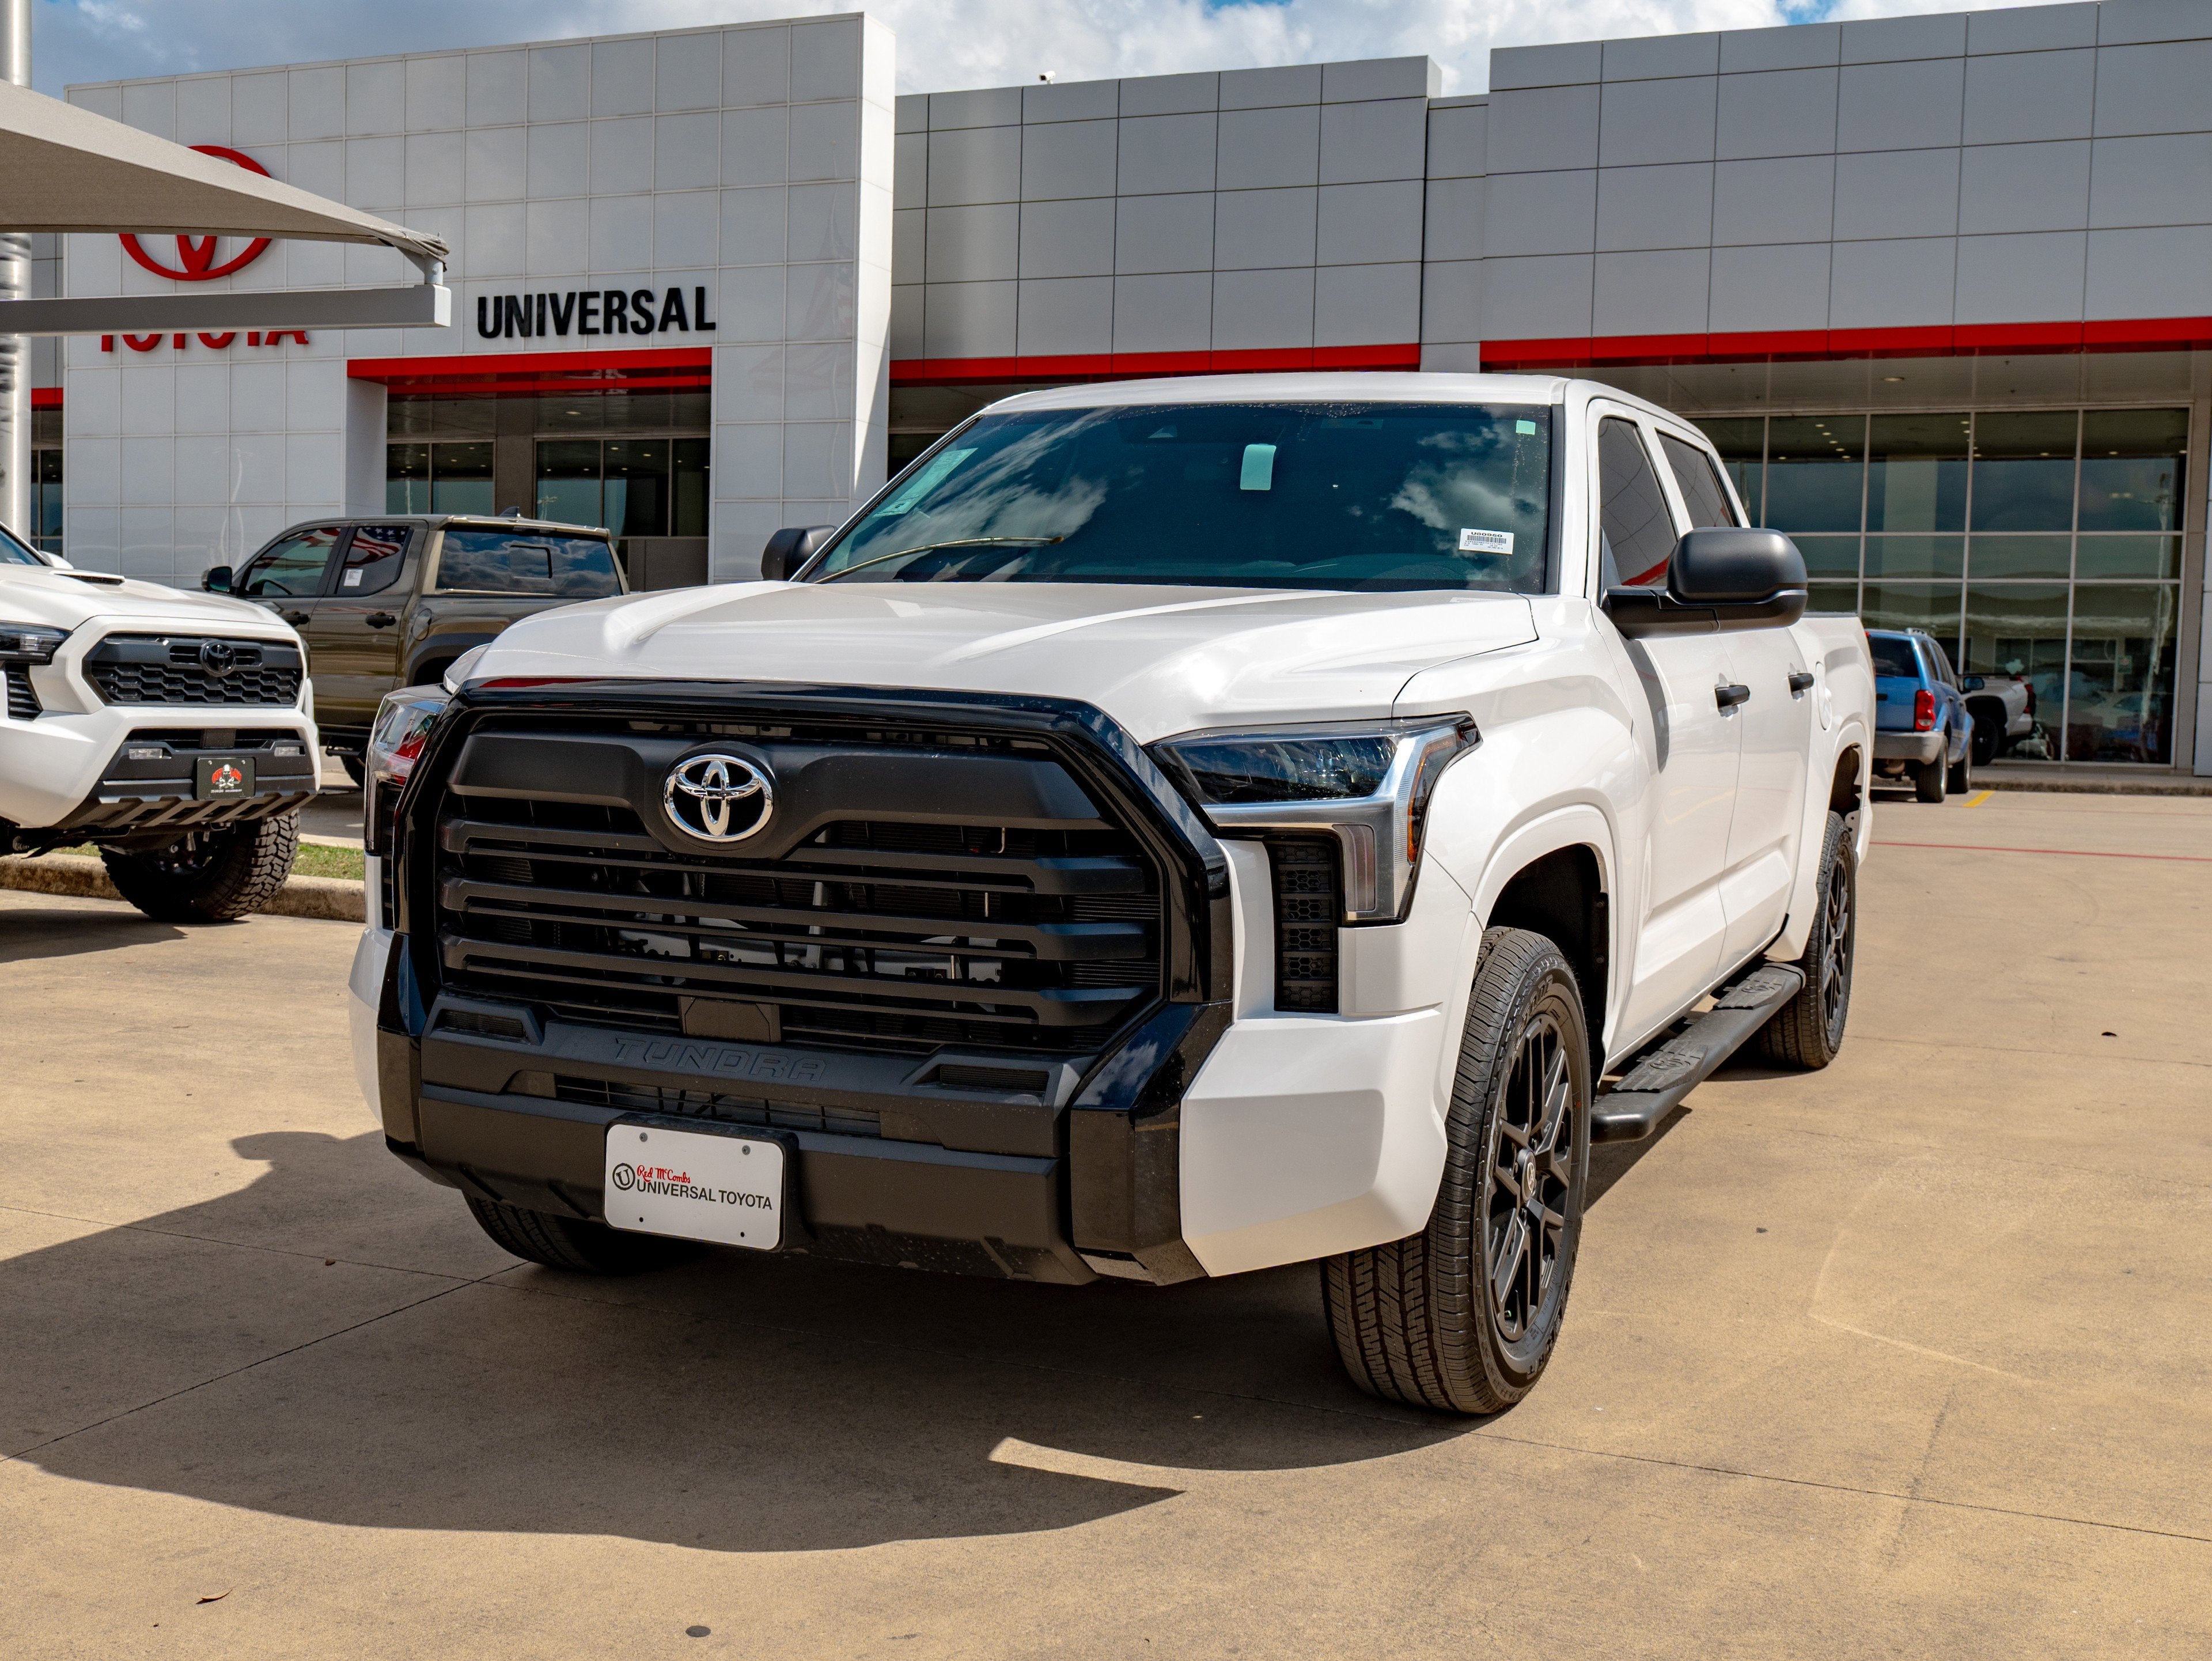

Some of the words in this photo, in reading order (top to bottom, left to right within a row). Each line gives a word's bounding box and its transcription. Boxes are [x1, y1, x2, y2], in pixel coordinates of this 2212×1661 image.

[478, 286, 716, 338] UNIVERSAL
[615, 1038, 826, 1081] TUNDRA
[637, 1164, 653, 1182] Red
[637, 1179, 717, 1202] UNIVERSAL
[718, 1190, 772, 1210] TOYOTA
